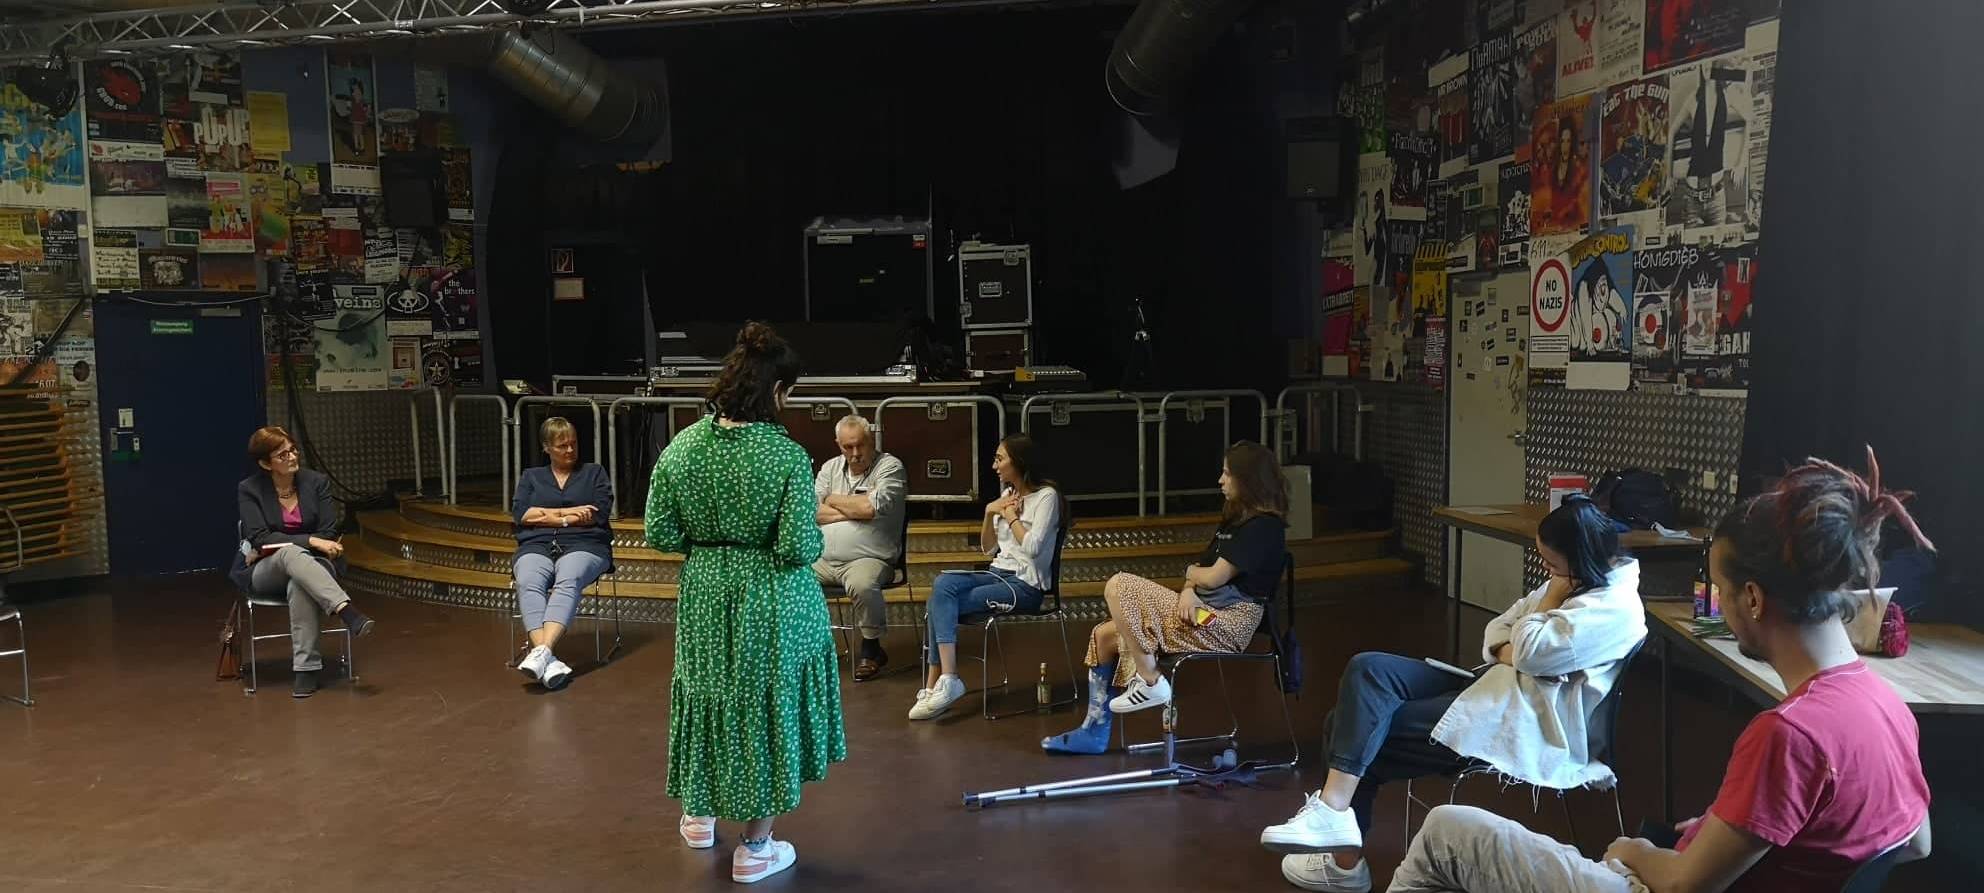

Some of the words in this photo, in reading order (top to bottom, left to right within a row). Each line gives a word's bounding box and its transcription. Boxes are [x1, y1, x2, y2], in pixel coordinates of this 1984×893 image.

[1545, 279, 1557, 292] NO
[335, 296, 382, 311] veins
[1539, 296, 1563, 311] NAZIS
